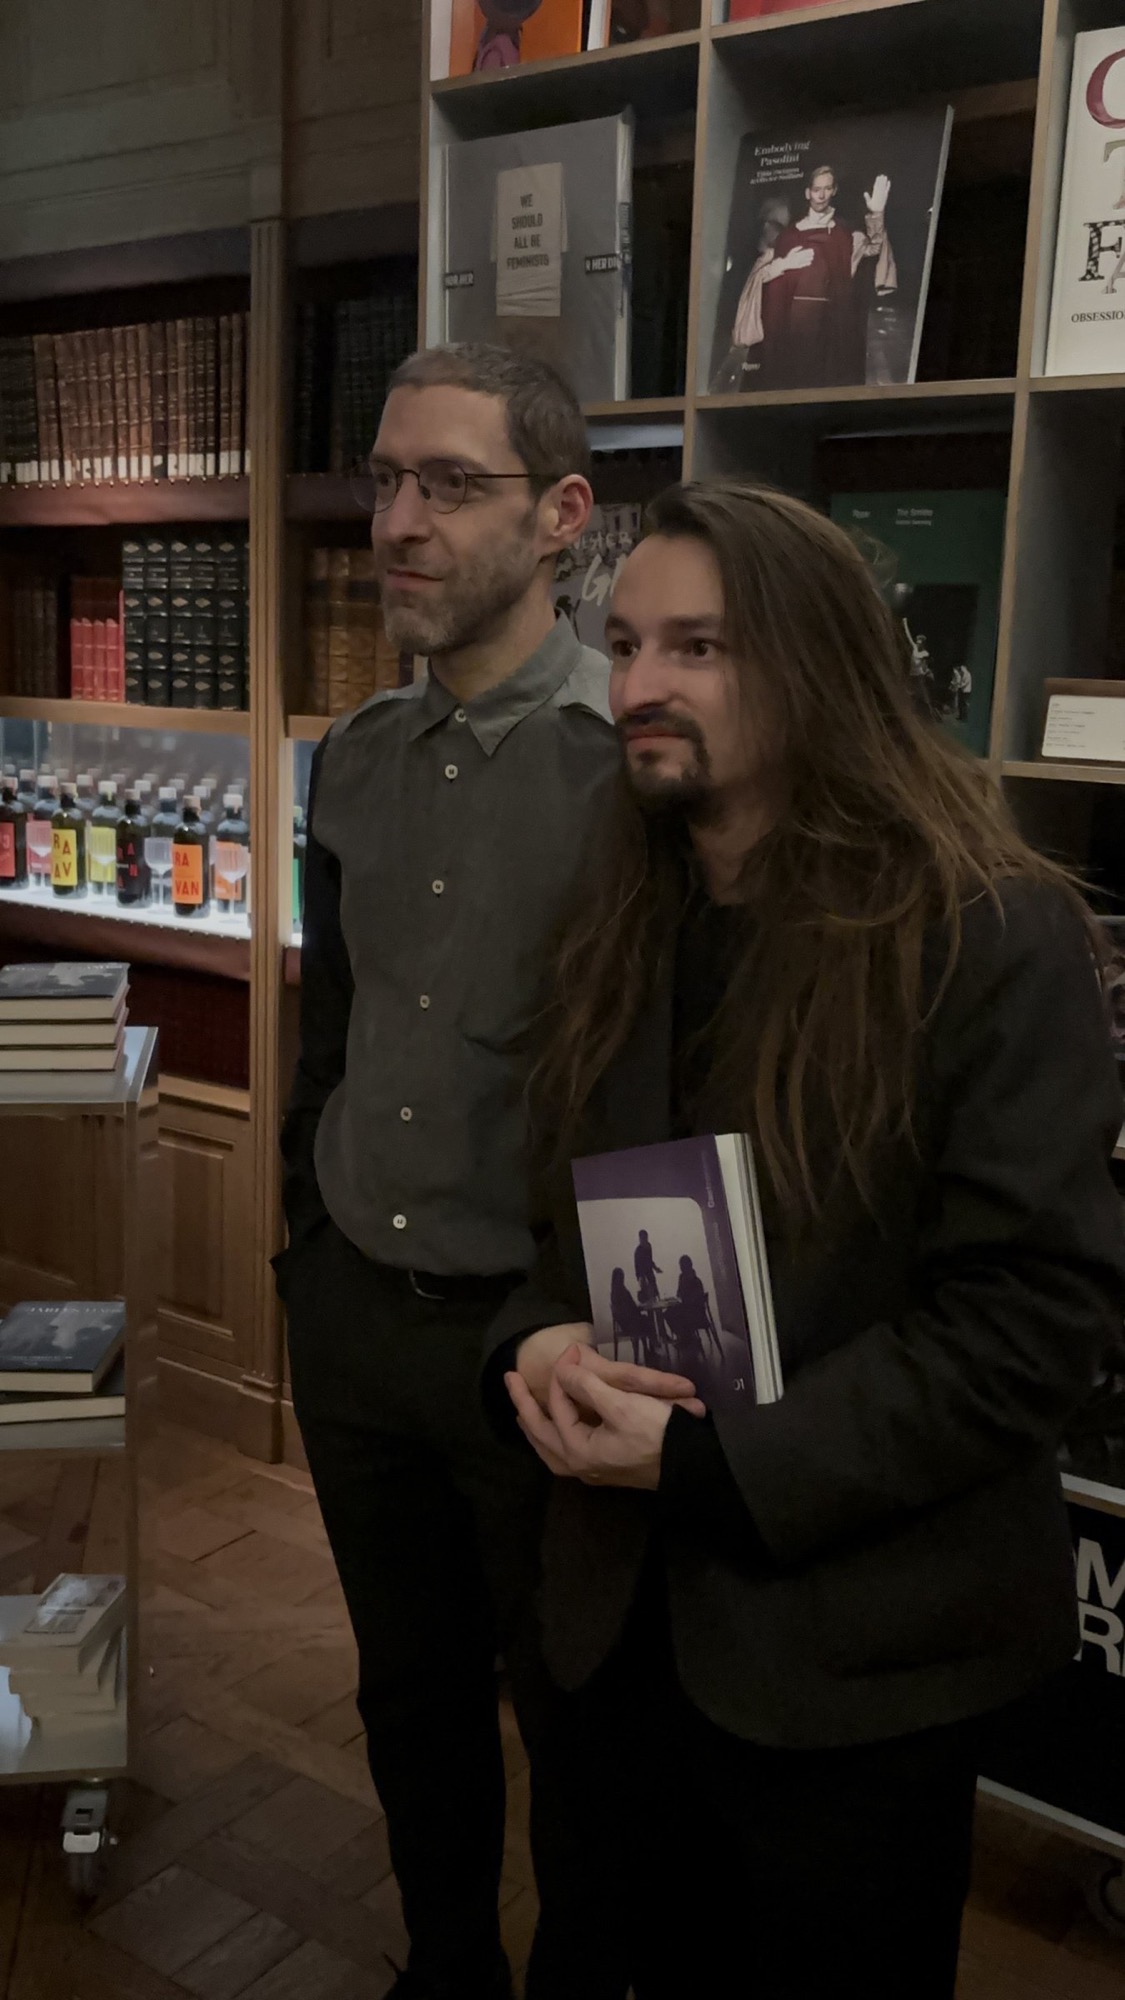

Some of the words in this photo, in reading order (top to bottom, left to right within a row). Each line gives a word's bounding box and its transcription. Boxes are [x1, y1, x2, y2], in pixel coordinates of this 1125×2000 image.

[520, 194, 533, 208] WE
[511, 212, 543, 230] SHOULD
[514, 235, 528, 249] ALL
[530, 233, 541, 248] BE
[506, 253, 550, 270] FEMINISTS
[1071, 310, 1125, 324] OBSESSIO
[174, 851, 190, 867] RA
[174, 880, 200, 896] VAN
